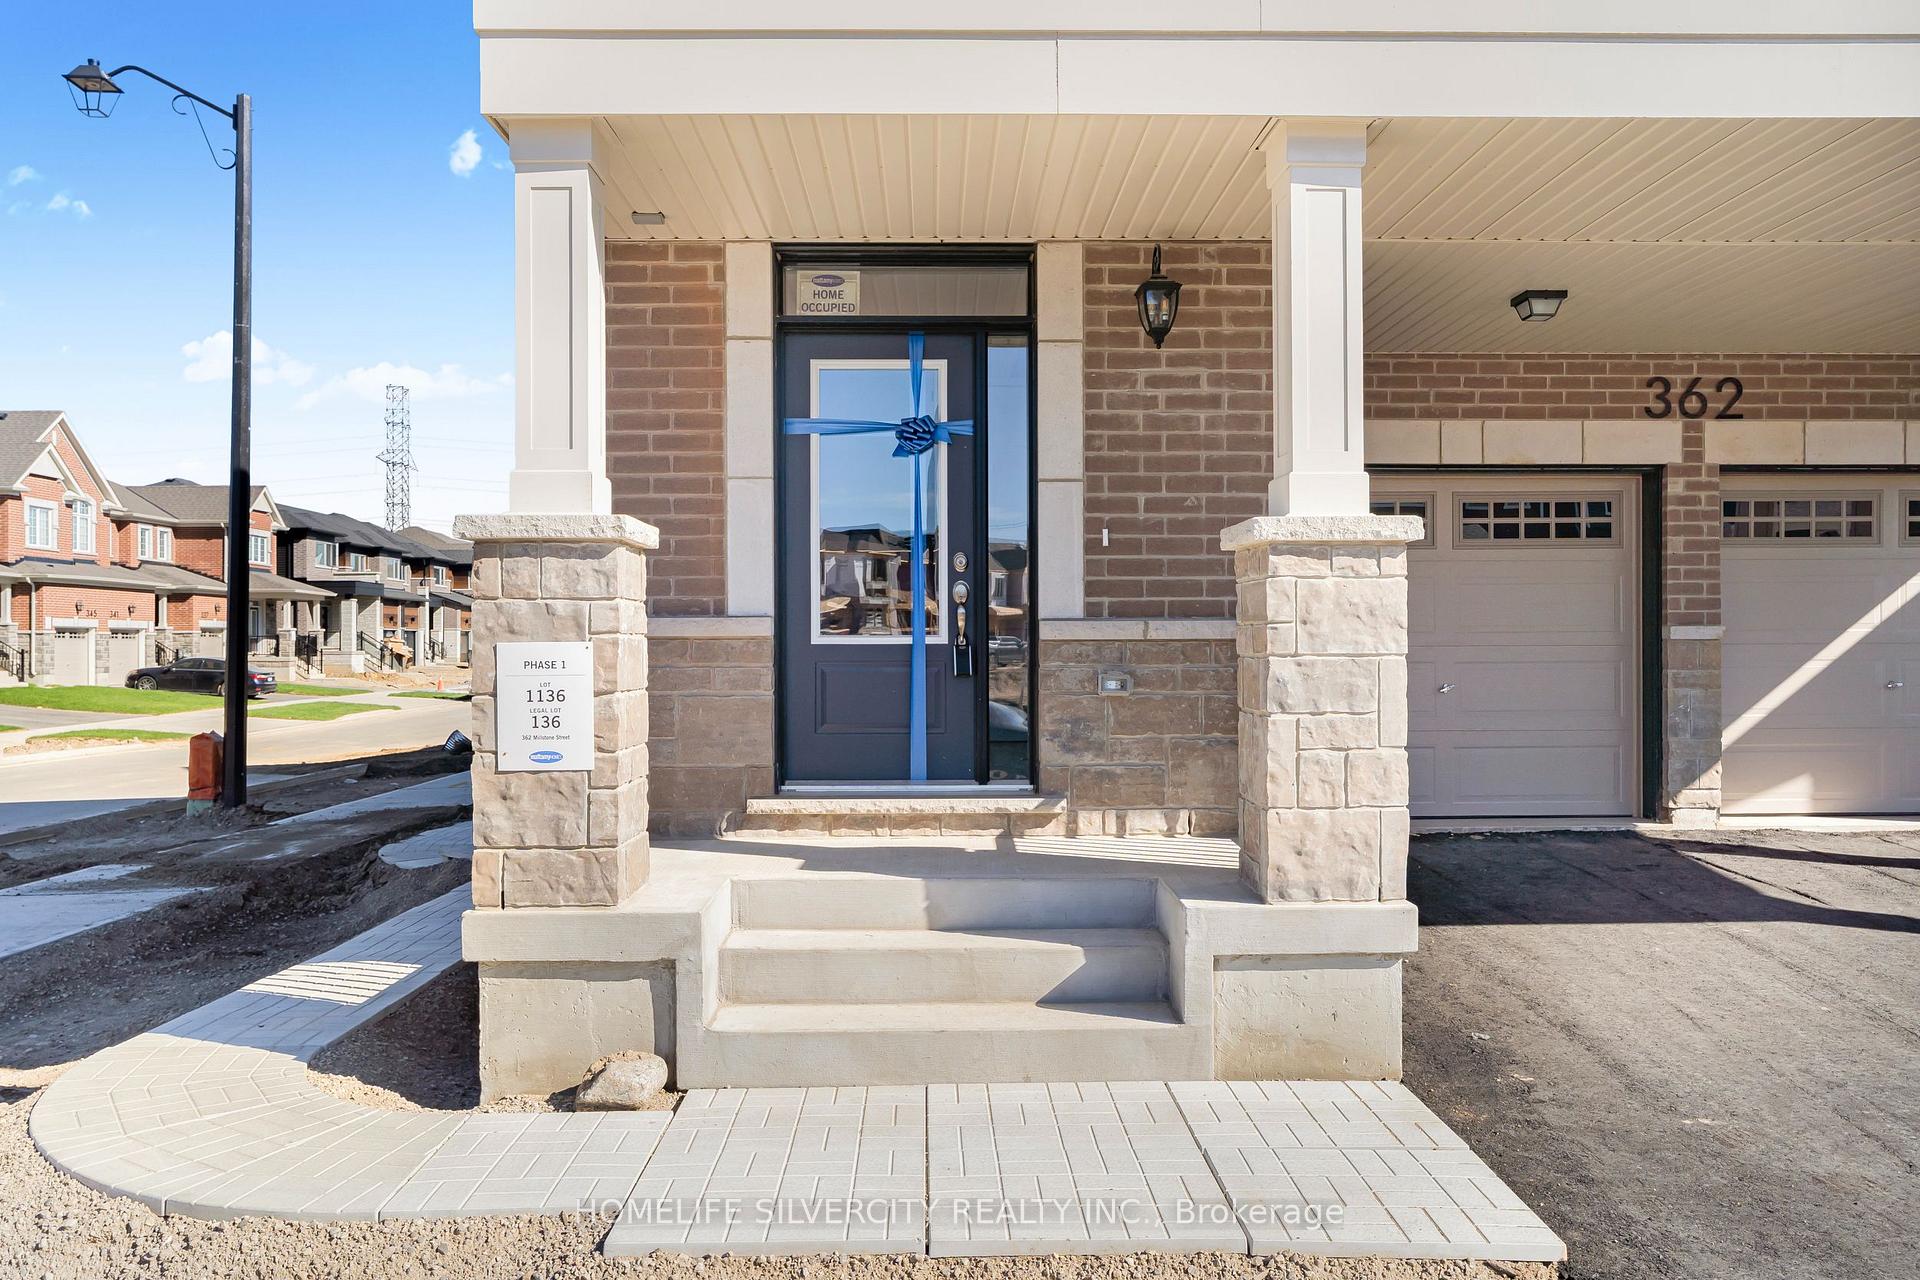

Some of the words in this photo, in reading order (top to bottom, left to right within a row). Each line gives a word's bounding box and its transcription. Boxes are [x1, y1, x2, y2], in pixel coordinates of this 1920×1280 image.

[813, 290, 844, 299] HOME
[801, 303, 855, 312] OCCUPIED
[1644, 376, 1744, 419] 362
[523, 660, 557, 669] PHASE
[561, 660, 567, 669] 1
[526, 689, 566, 702] 1136
[531, 715, 561, 729] 136
